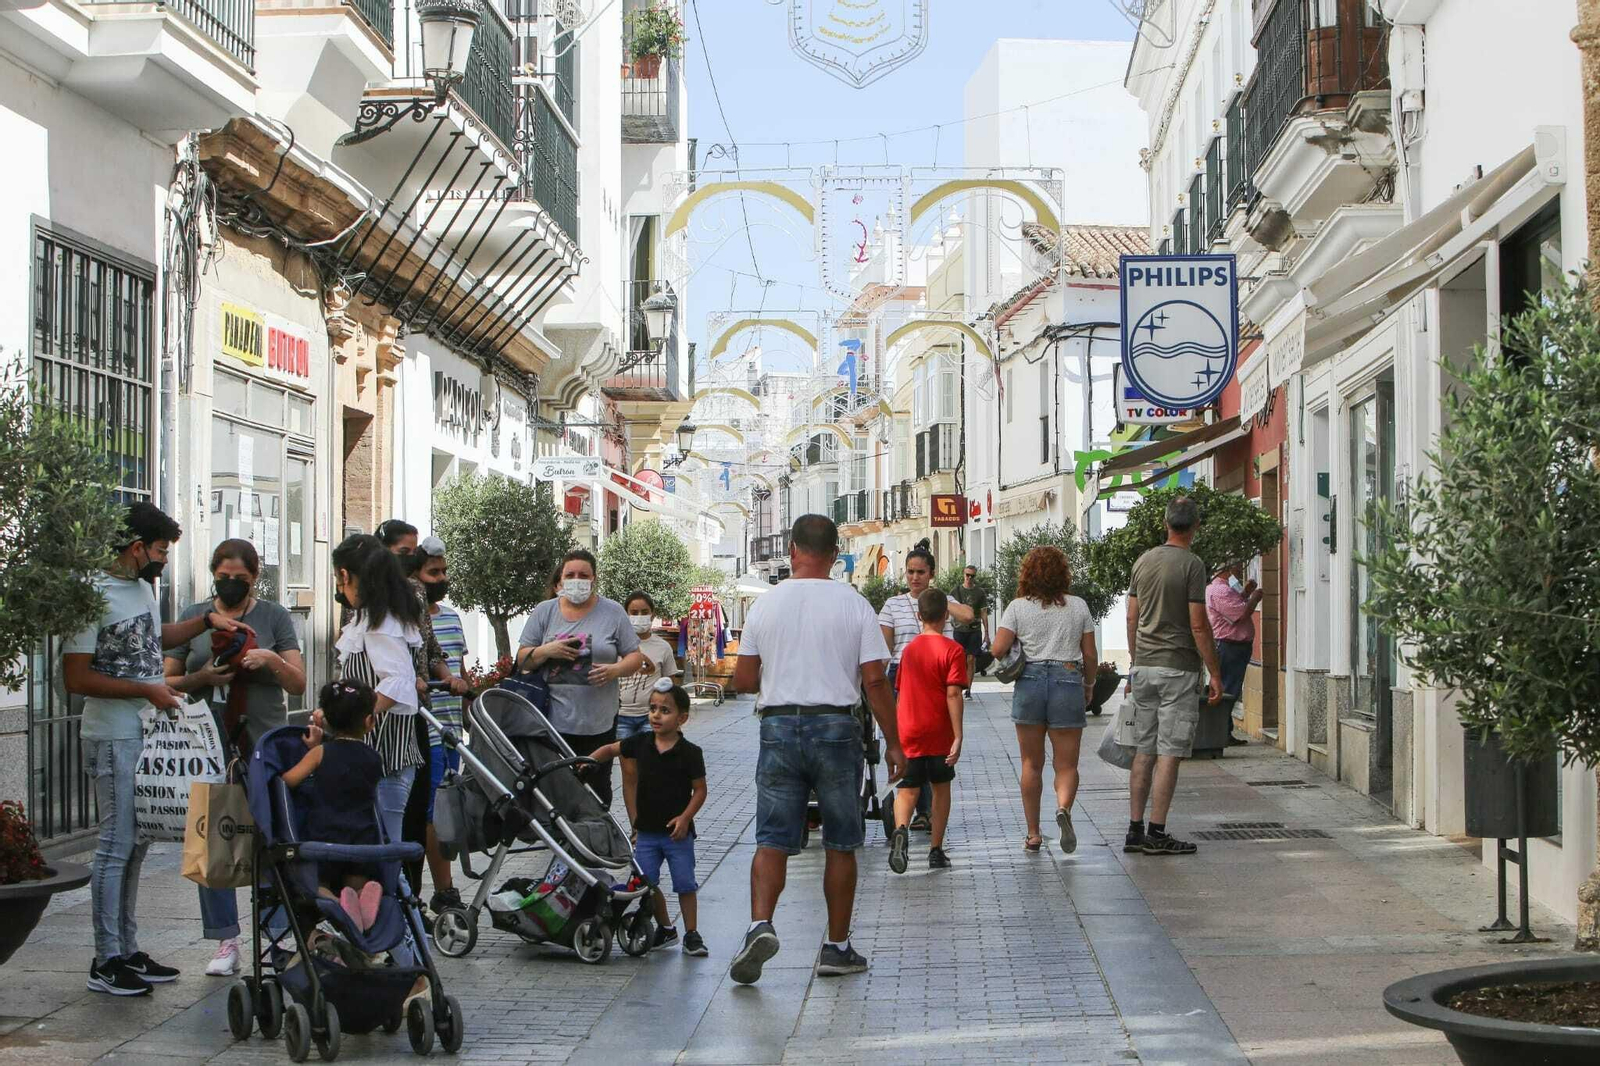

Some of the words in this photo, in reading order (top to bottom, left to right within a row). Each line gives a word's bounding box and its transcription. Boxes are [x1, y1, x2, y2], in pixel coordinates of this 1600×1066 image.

[1128, 266, 1228, 287] PHILIPS
[1127, 408, 1143, 418] TV
[1146, 407, 1187, 418] COLOR
[150, 804, 189, 816] PASSIO
